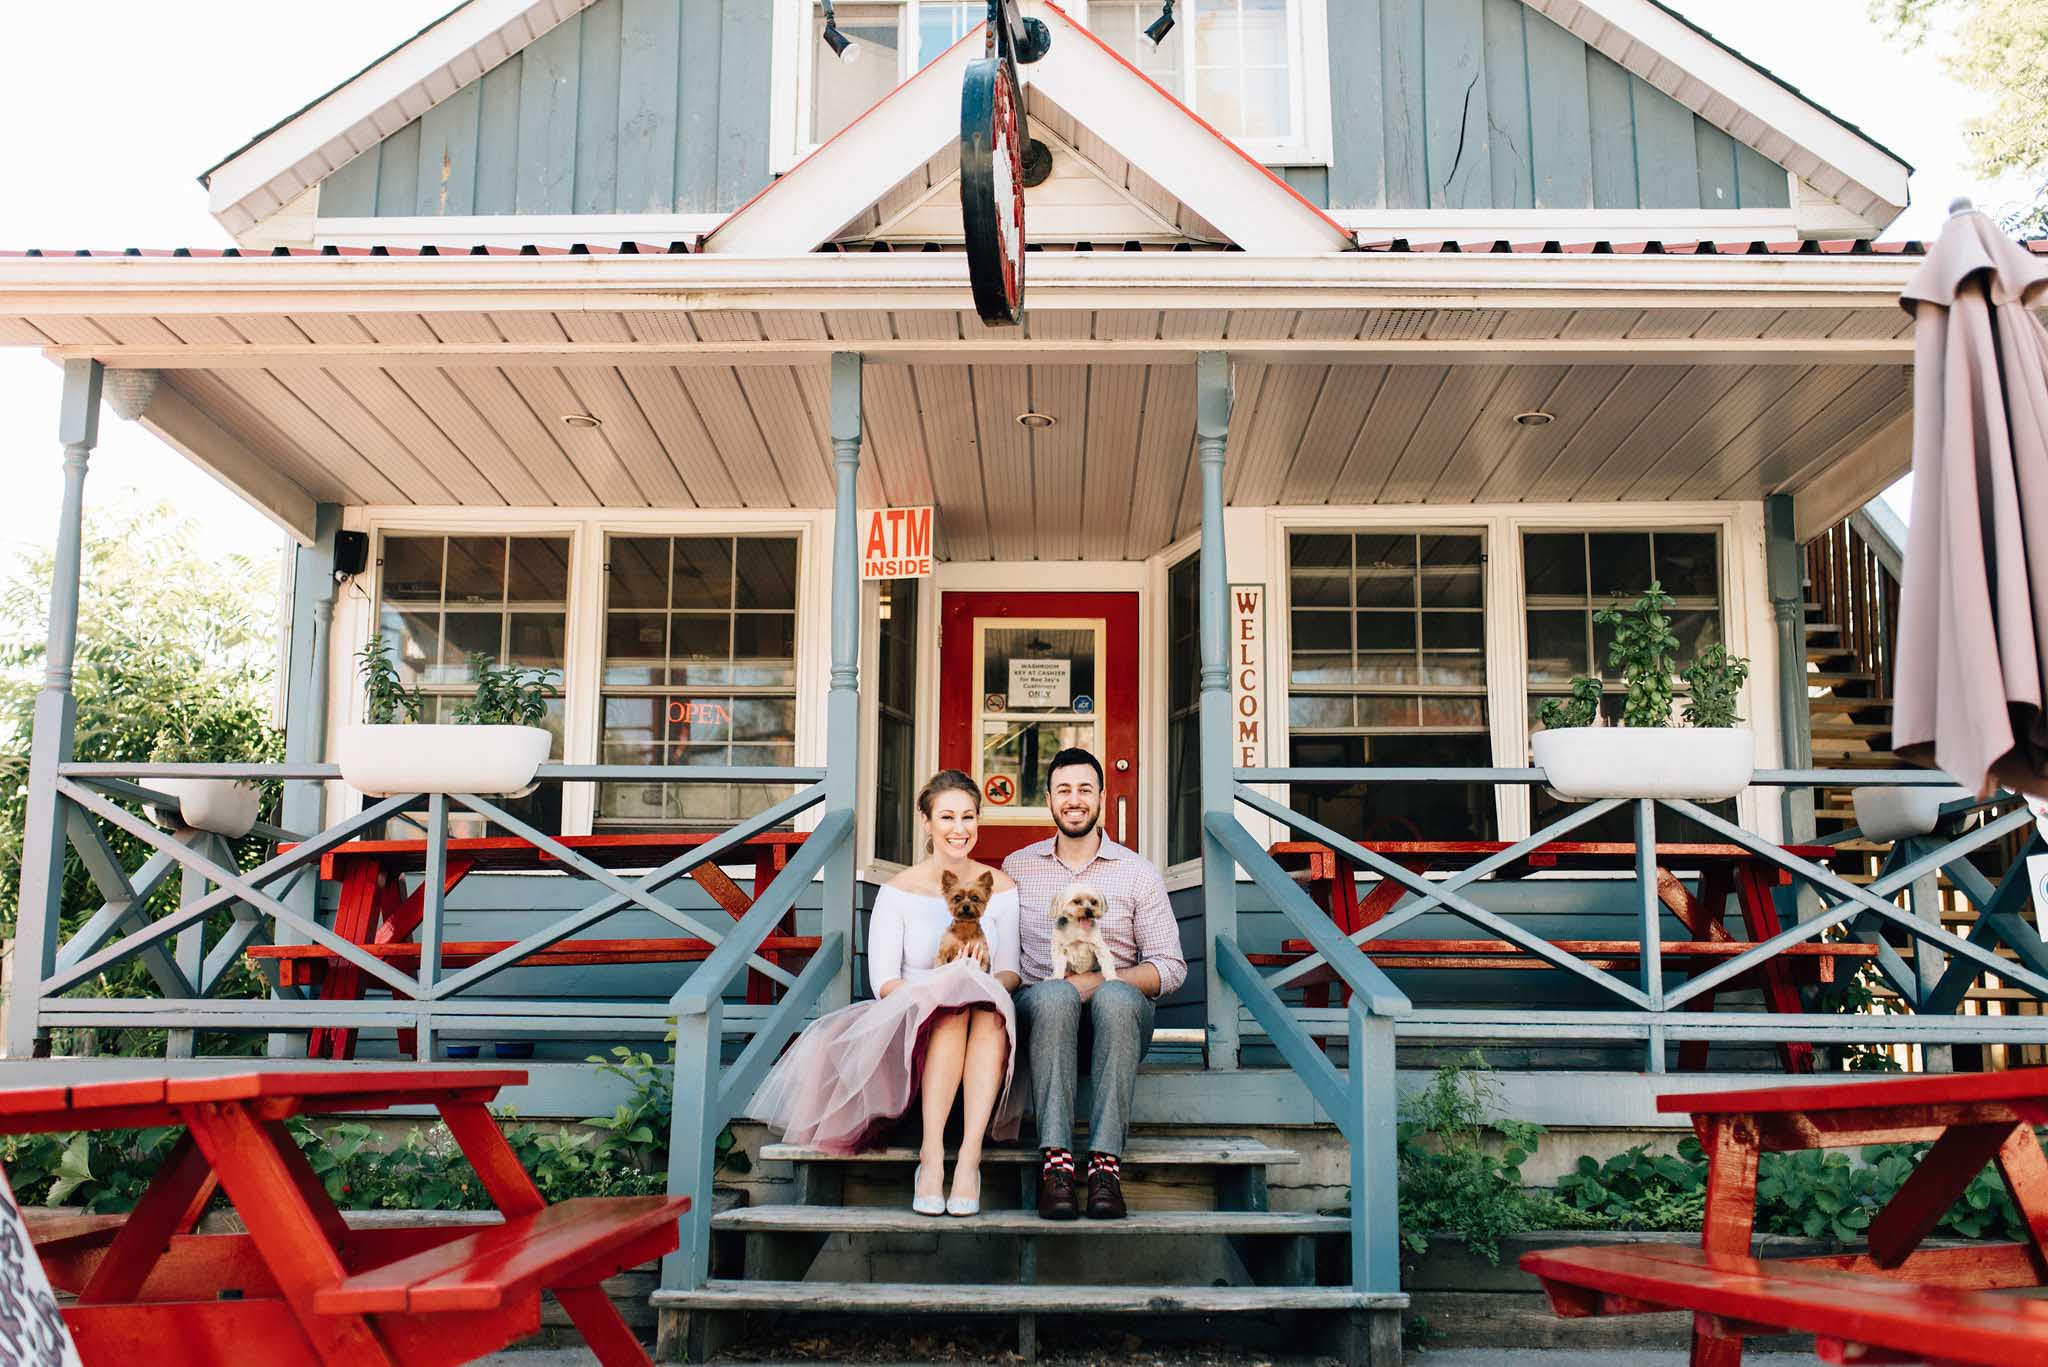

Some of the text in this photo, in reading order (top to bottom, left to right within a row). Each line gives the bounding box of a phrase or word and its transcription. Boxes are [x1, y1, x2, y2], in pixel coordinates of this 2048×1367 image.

[866, 508, 931, 559] ATM
[865, 559, 930, 577] INSIDE
[1236, 592, 1259, 769] WELCOME
[668, 701, 731, 725] OPEN
